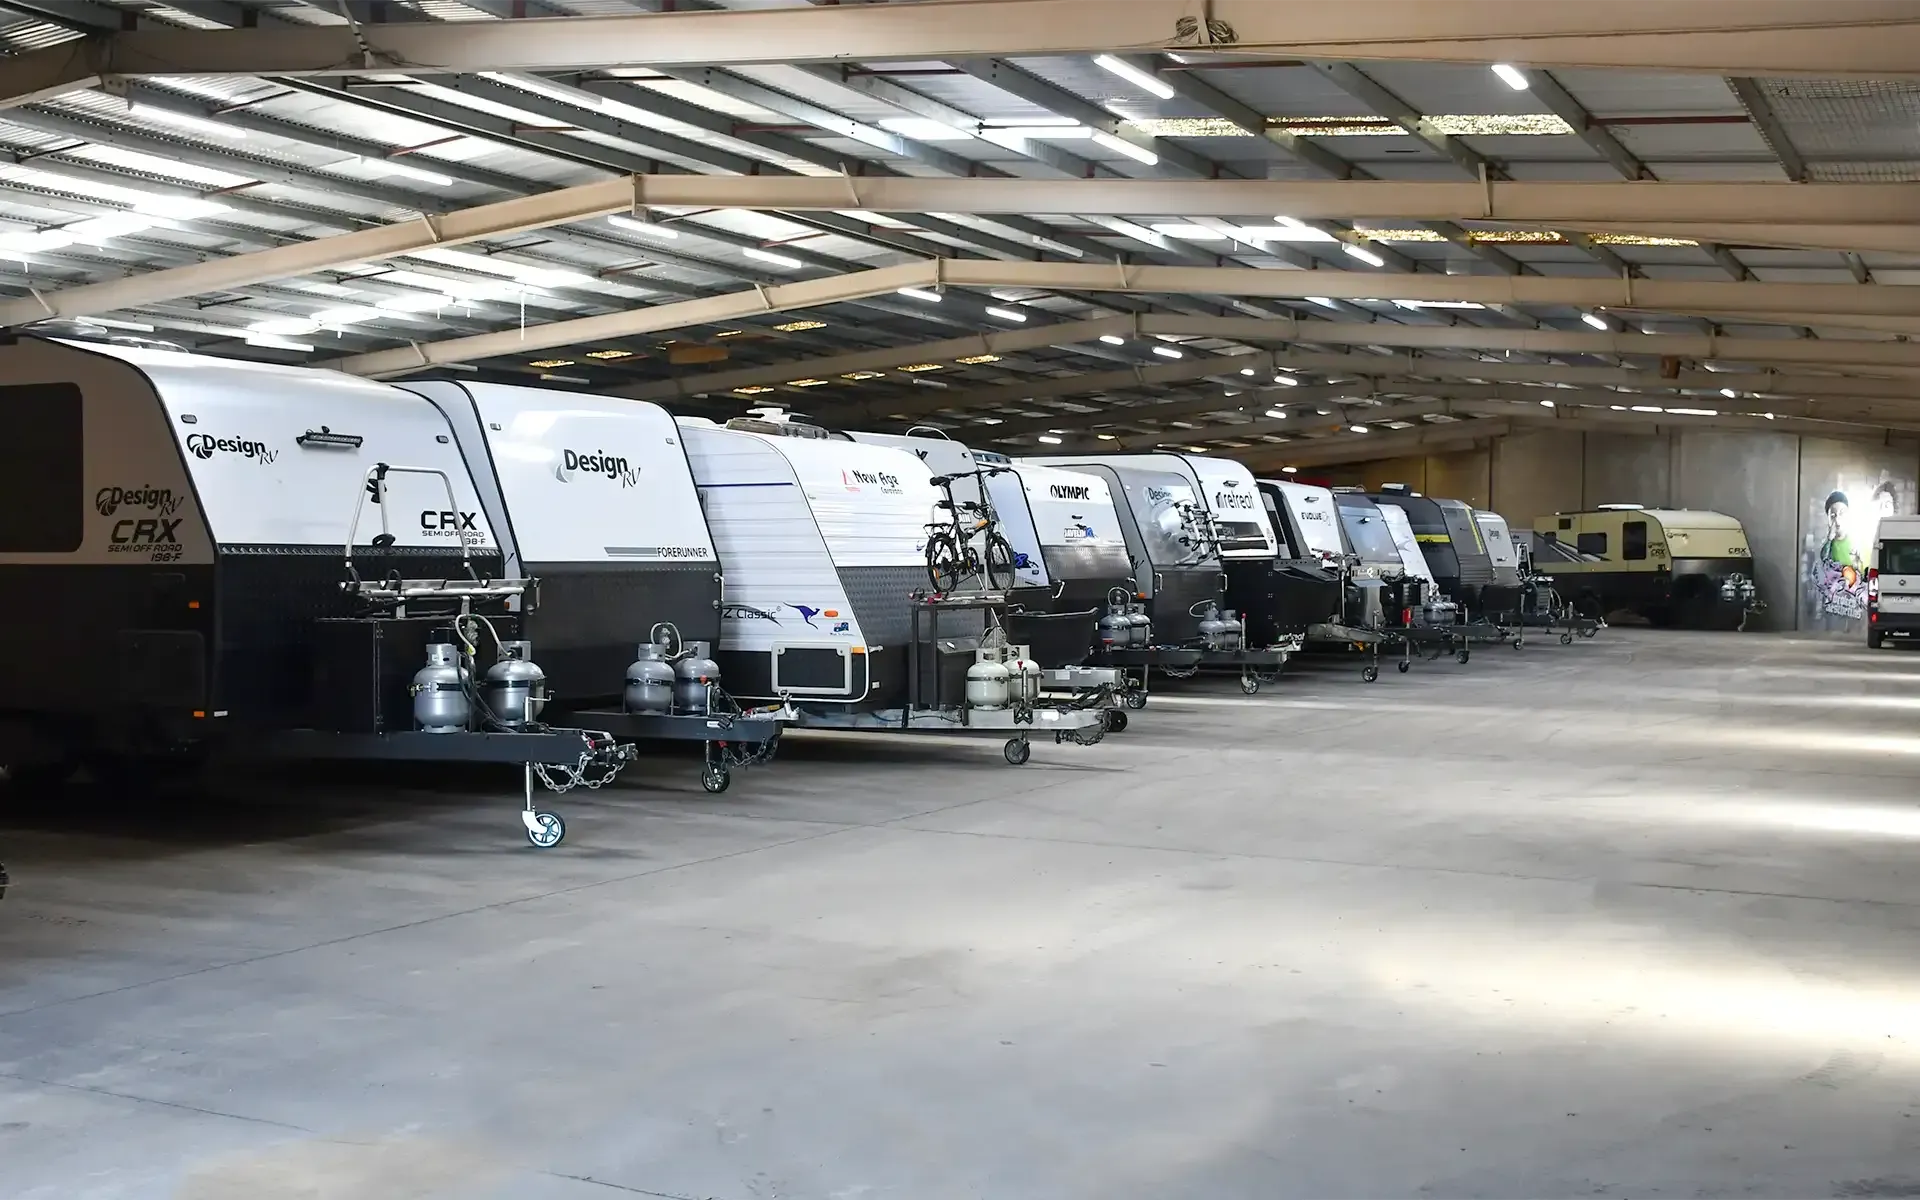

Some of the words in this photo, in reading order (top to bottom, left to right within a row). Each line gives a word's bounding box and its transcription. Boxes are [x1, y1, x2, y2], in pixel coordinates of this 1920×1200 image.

[202, 434, 266, 458] Design
[260, 449, 279, 465] RV
[563, 448, 628, 480] Design
[620, 467, 641, 489] RV
[852, 469, 878, 484] New
[878, 471, 900, 488] Age
[110, 484, 171, 510] Design
[159, 496, 184, 518] RV
[1050, 484, 1090, 500] OLYMPIC
[1223, 490, 1255, 509] retreat
[421, 510, 477, 530] CRX
[110, 518, 184, 543] CRX
[107, 544, 132, 553] SEMI
[133, 544, 153, 553] OFF
[153, 544, 183, 552] ROAD
[466, 538, 486, 546] 98-F
[150, 553, 183, 562] 198-F
[657, 547, 708, 558] FORERUNNER
[736, 607, 777, 619] Classic
